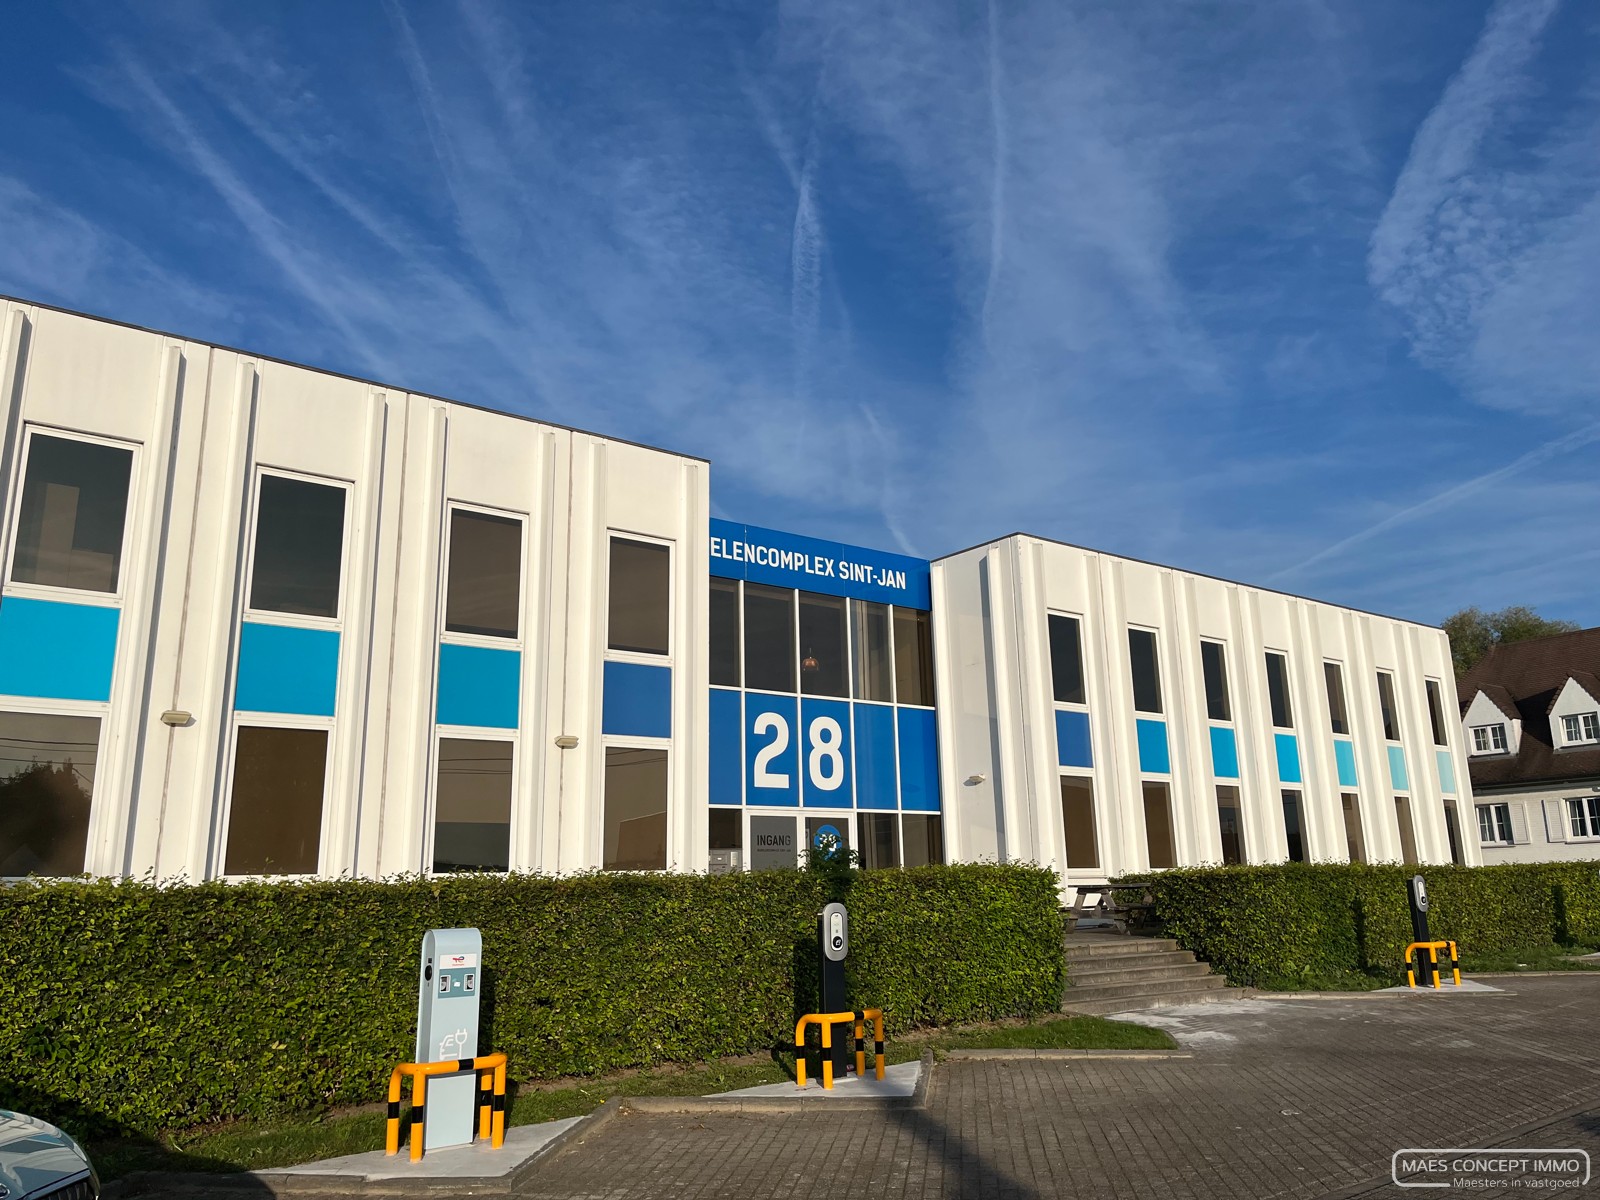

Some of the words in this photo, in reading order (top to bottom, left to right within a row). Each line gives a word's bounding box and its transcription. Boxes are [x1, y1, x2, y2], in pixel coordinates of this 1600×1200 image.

[710, 536, 835, 577] ELENCOMPLEX
[839, 561, 906, 590] SINT-JAN
[753, 712, 844, 791] 28
[757, 834, 791, 846] INGANG
